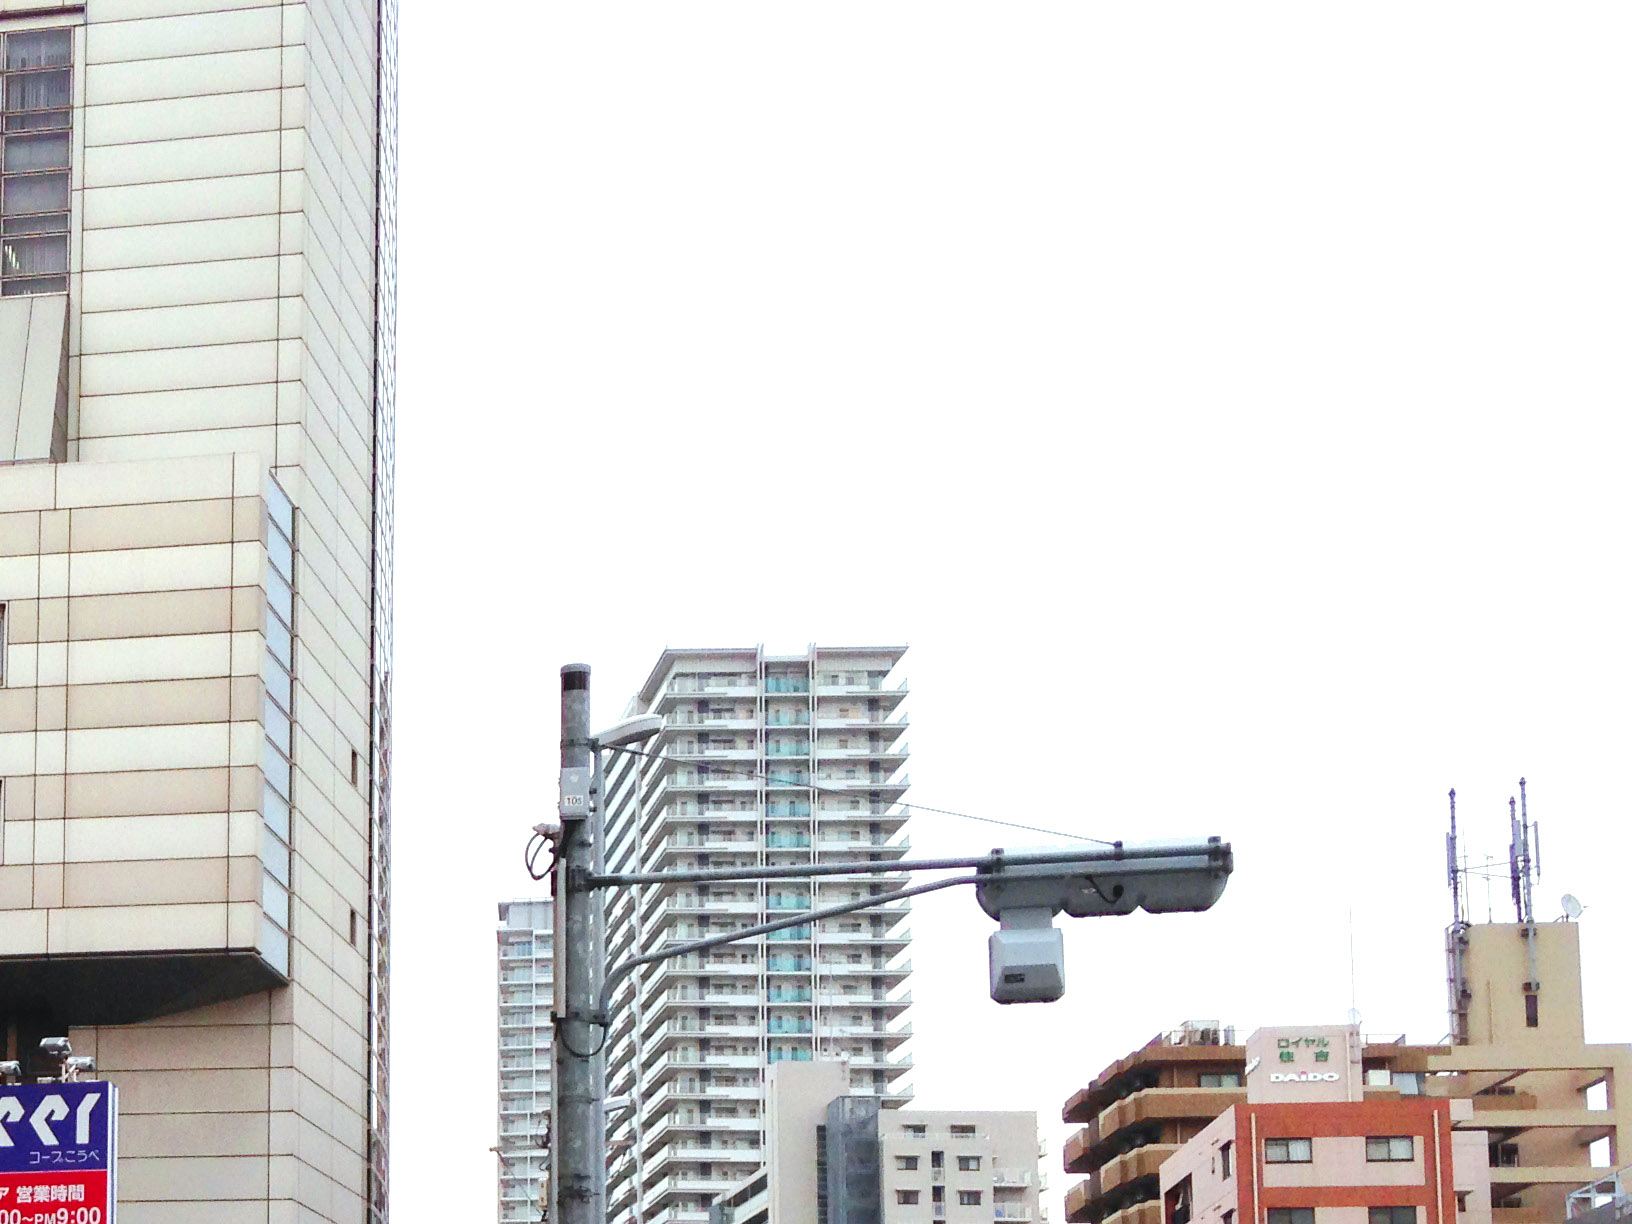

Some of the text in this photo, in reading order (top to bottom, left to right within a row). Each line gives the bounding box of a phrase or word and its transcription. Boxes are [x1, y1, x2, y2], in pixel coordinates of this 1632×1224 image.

[29, 1150, 100, 1165] コープこうべ
[16, 1184, 85, 1203] 営業時間
